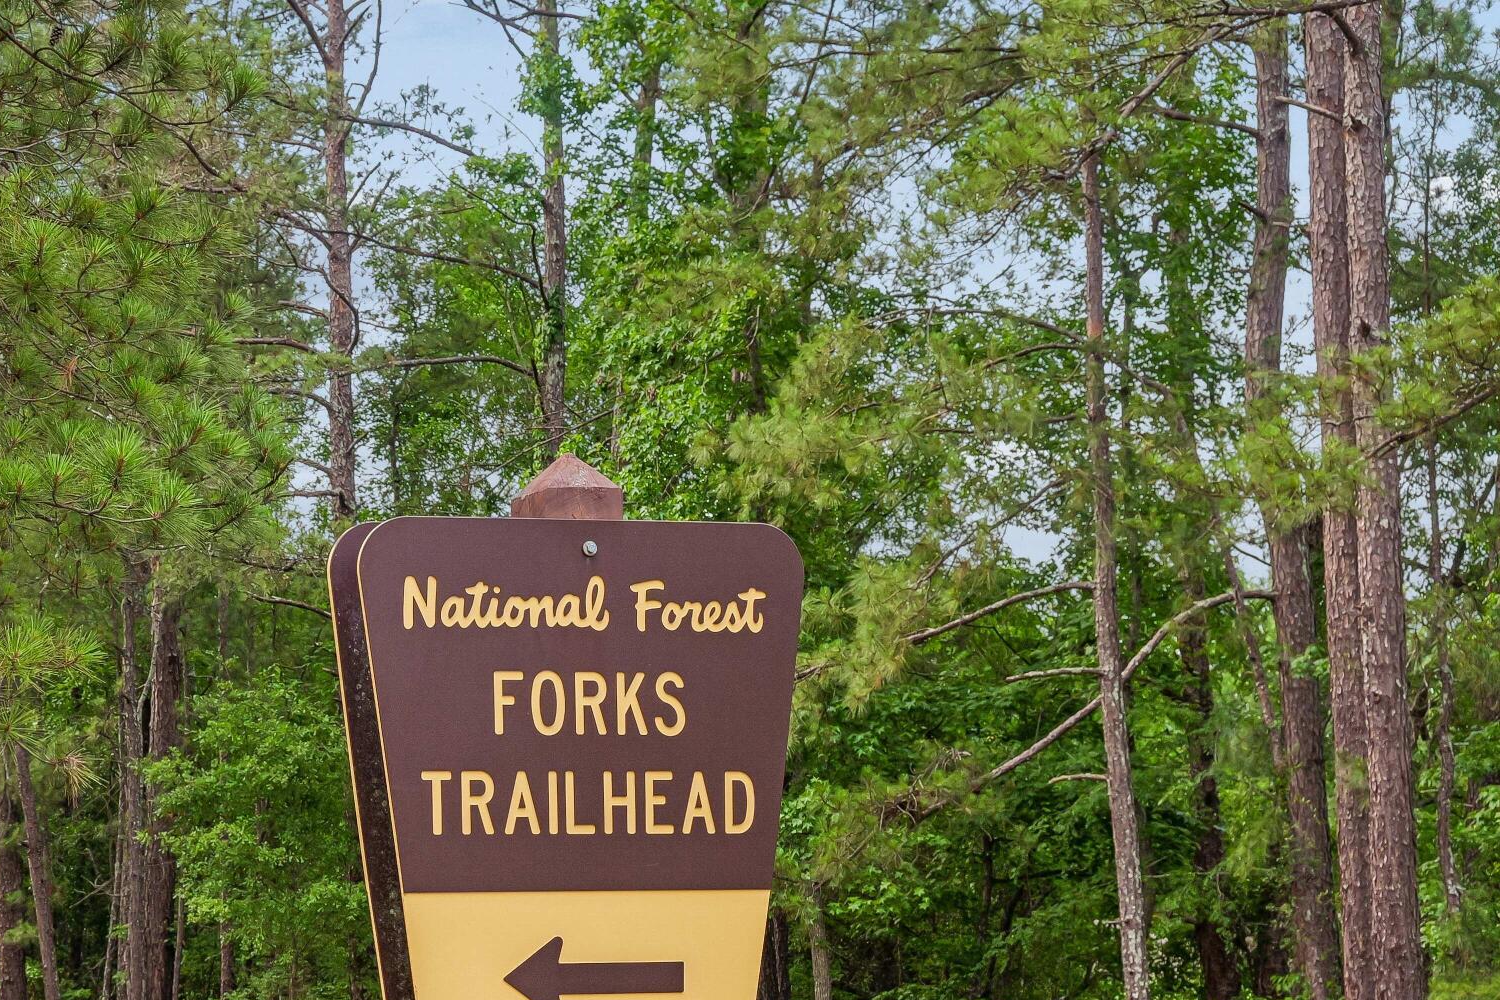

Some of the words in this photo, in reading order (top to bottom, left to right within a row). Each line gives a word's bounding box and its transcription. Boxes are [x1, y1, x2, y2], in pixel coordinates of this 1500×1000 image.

[403, 575, 609, 632] National
[630, 580, 766, 633] Forest
[493, 671, 686, 737] FORKS
[421, 771, 756, 836] TRAILHEAD
